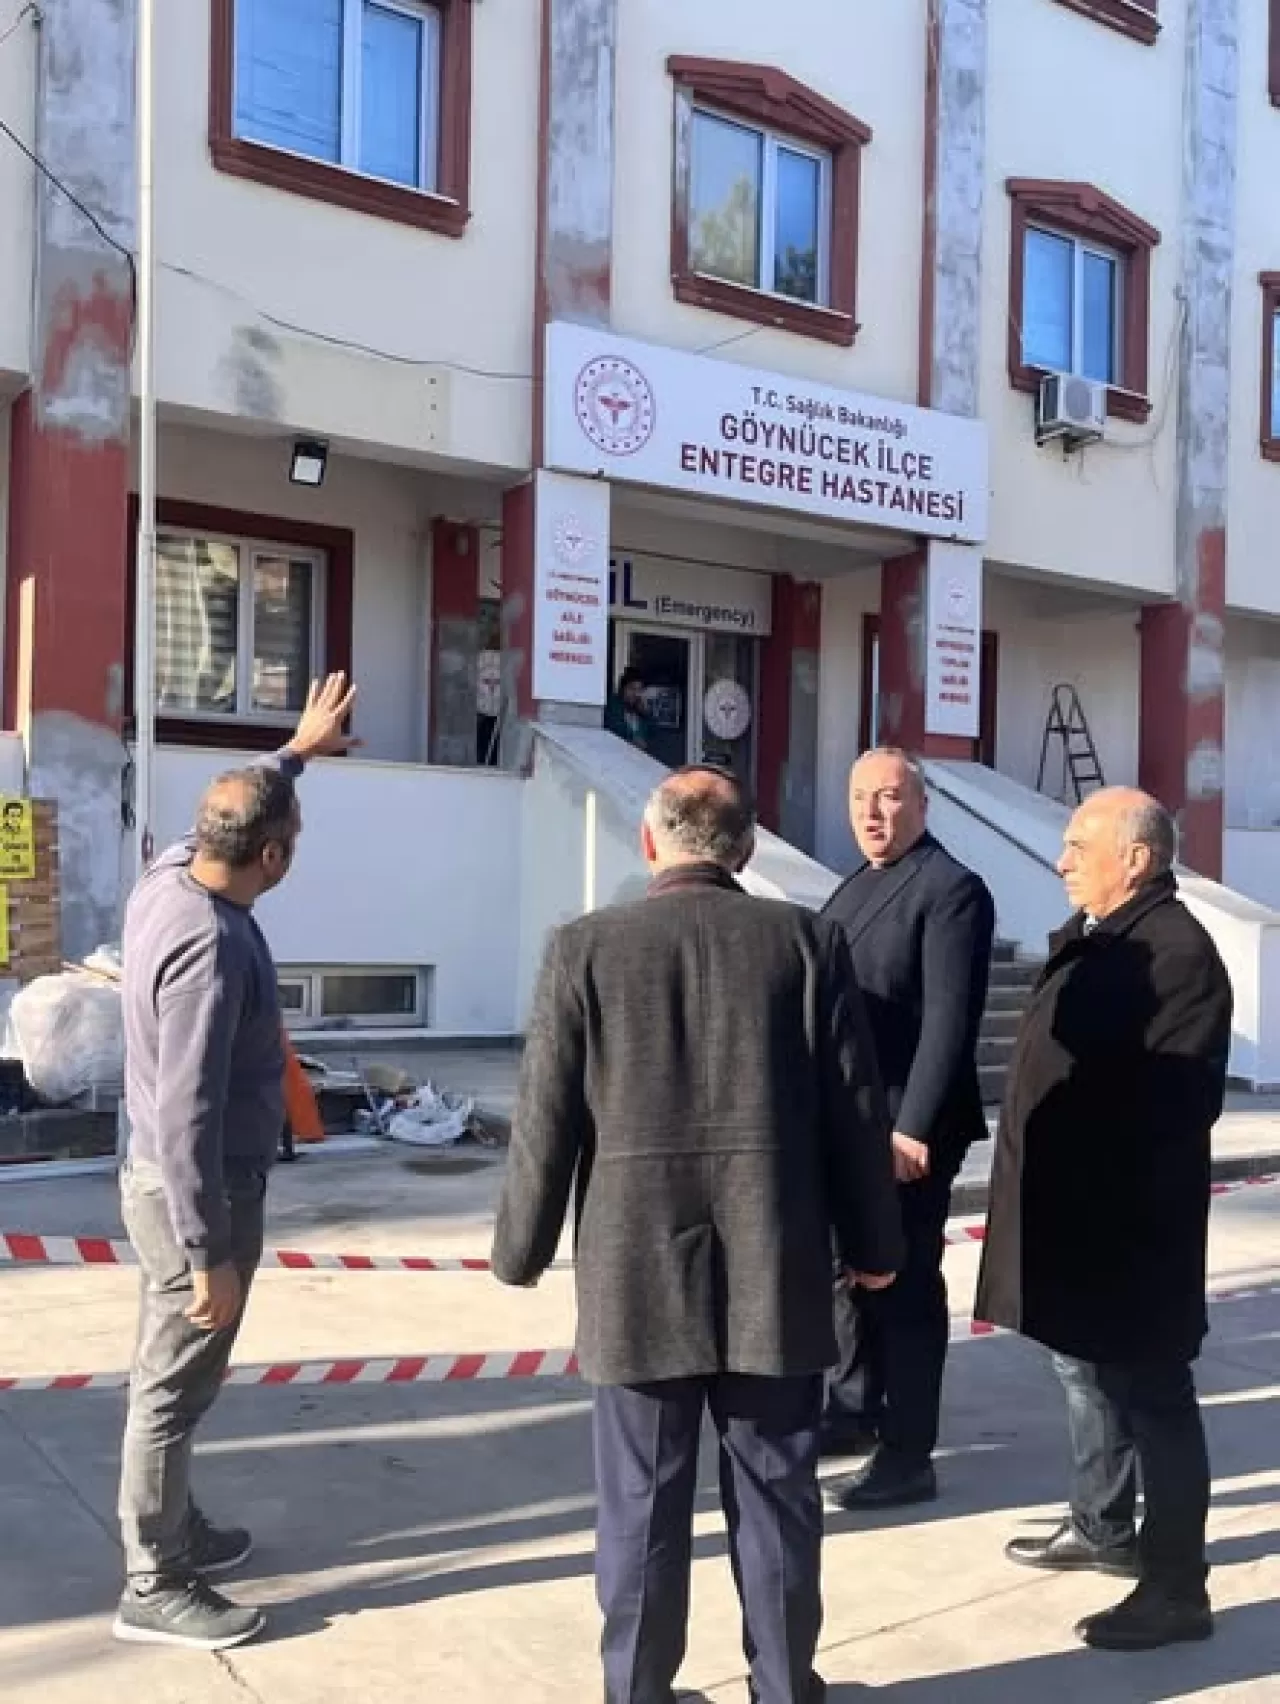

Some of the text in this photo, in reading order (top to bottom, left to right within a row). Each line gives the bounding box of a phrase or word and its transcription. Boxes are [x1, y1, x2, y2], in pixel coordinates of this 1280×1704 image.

[751, 386, 908, 439] T.C. Sağlık Bakanlığı
[720, 410, 934, 480] GÖYNÜCEK İLÇE
[680, 442, 964, 522] ENTEGRE HASTANESİ
[655, 595, 755, 626] (Emergency)
